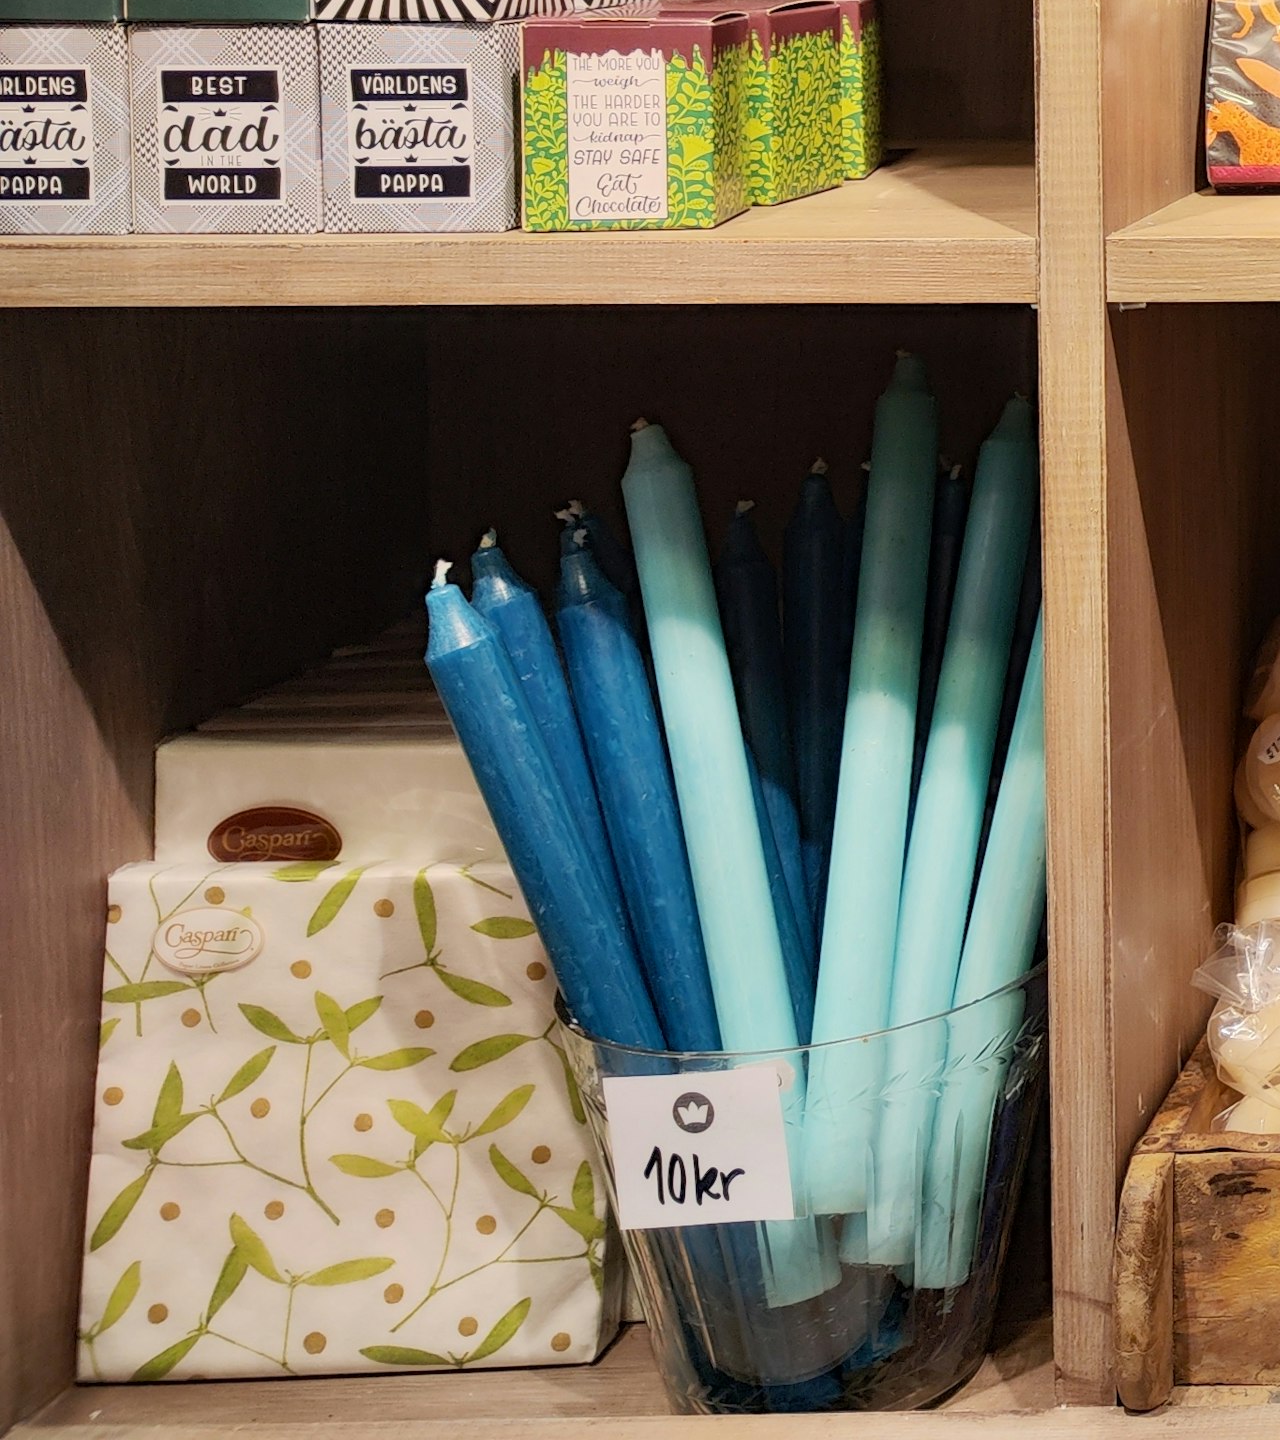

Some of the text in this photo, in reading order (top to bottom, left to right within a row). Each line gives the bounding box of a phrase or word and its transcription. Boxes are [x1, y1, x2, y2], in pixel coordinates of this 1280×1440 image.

[573, 57, 660, 72] THE MORE YOU
[0, 76, 76, 96] RLDENS
[191, 76, 248, 96] BEST
[361, 74, 457, 95] VÄRLDENS
[591, 74, 644, 90] weigh
[573, 94, 660, 109] THE HARDER
[573, 111, 661, 127] YOU ARE TO
[0, 117, 85, 152] ästa
[163, 115, 280, 153] dad
[355, 116, 467, 150] bästa
[587, 130, 648, 147] kidnap
[200, 155, 242, 166] IN THE
[574, 148, 661, 166] STAY SAFE
[0, 175, 63, 195] PAPPA
[187, 175, 257, 195] WORLD
[380, 174, 444, 193] PAPPA
[597, 173, 643, 197] Eat
[576, 195, 661, 217] Chocolate
[222, 826, 328, 861] Caspari
[165, 923, 252, 959] Caspari
